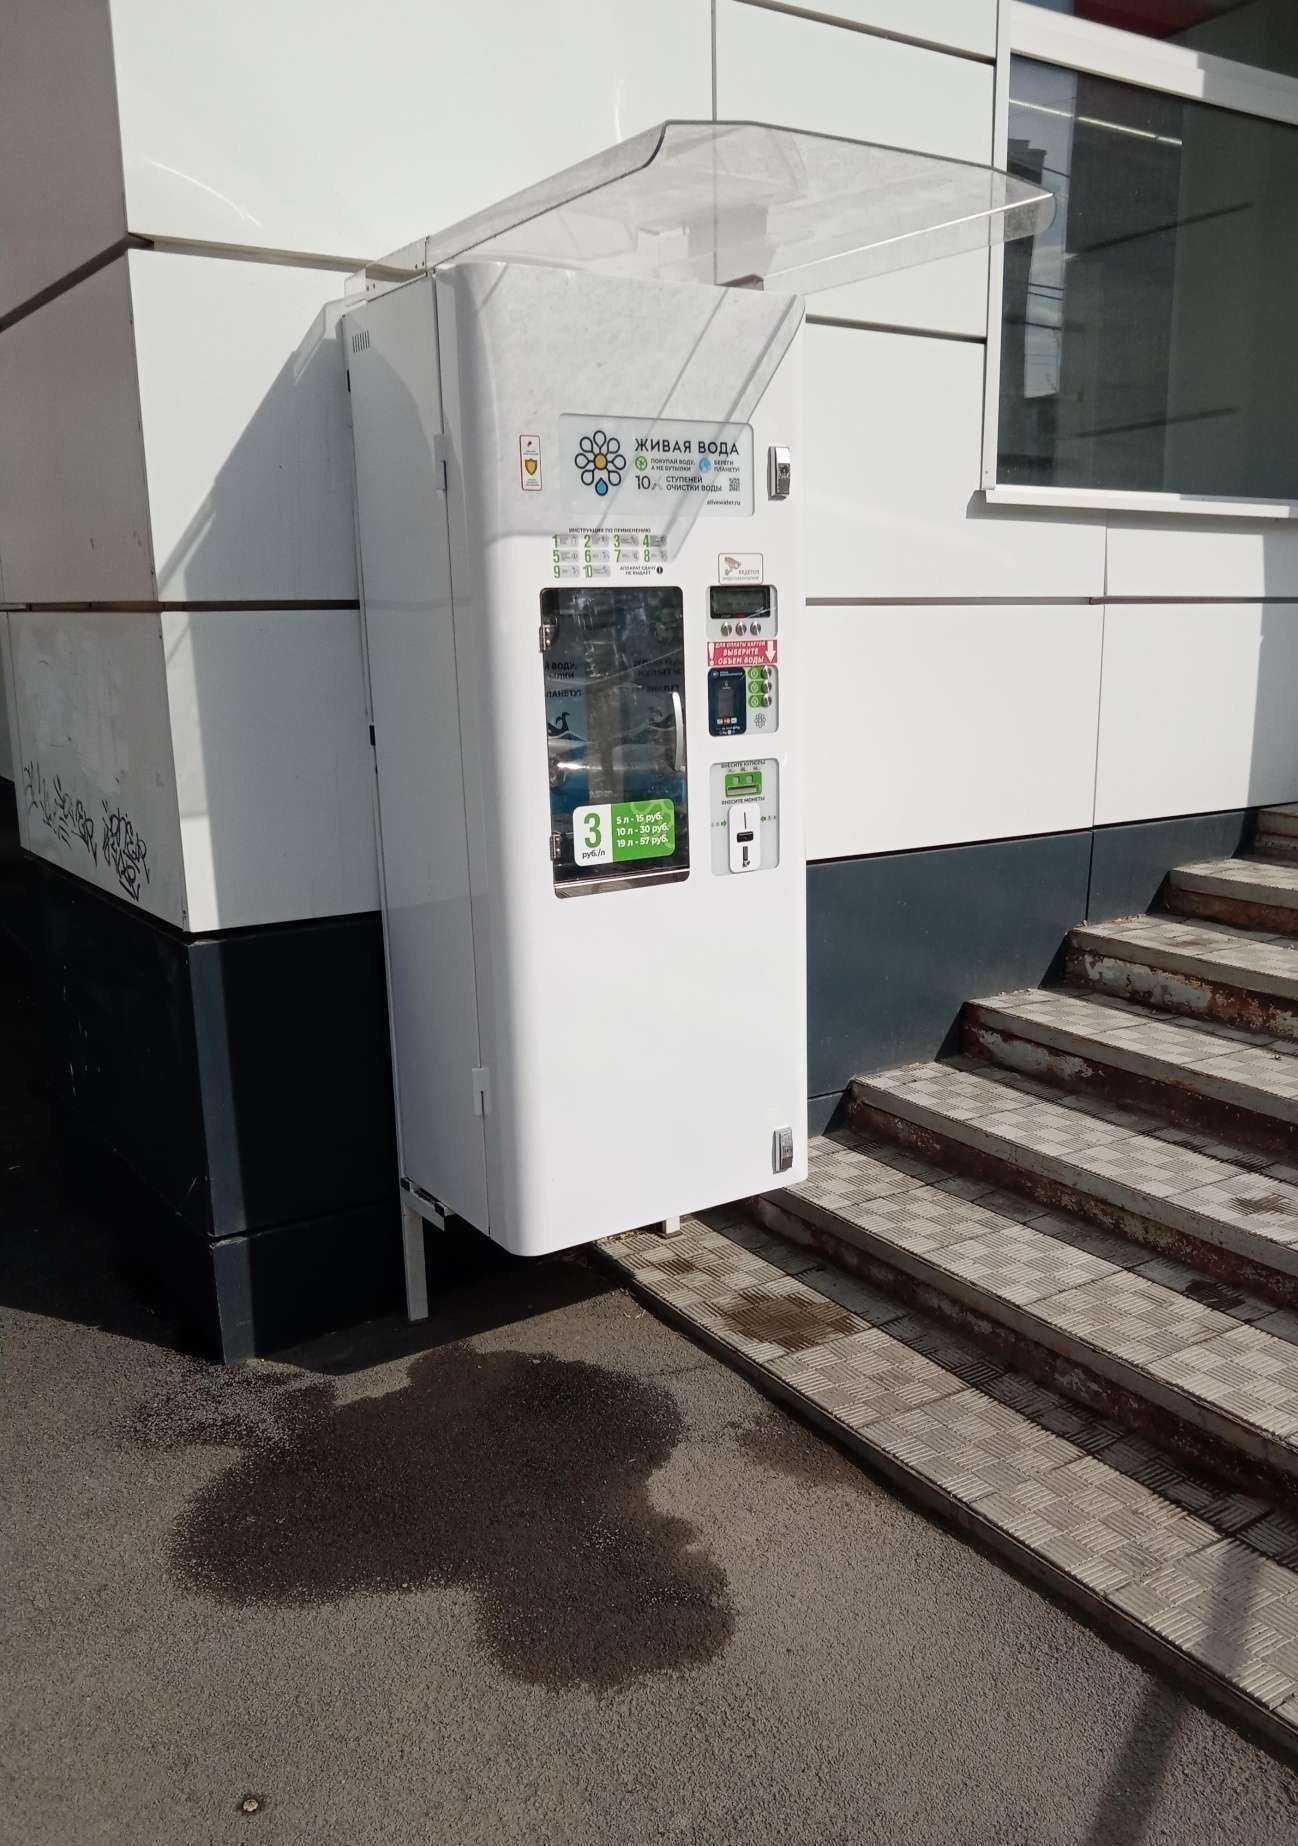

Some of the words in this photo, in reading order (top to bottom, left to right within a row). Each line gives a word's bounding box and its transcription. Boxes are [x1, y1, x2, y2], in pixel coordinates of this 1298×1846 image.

[634, 438, 692, 454] ЖИВАЯ
[697, 440, 740, 457] ВОДА
[650, 457, 678, 465] ПОКУПАЙ
[634, 475, 651, 490] 10
[665, 475, 703, 483] СТУПЕНЕЙ
[666, 484, 700, 492] ОЧИСТКИ
[701, 485, 722, 493] ВОДЫ
[584, 534, 592, 548] 2
[614, 534, 621, 548] 3
[642, 534, 650, 548] 4
[552, 549, 560, 563] 5
[584, 549, 592, 563] 6
[614, 549, 621, 563] 7
[643, 549, 650, 563] 8
[553, 565, 560, 579] 9
[583, 565, 593, 579] 10
[723, 648, 759, 657] ВЫБЕРИТЕ
[743, 656, 764, 665] ВОДЫ
[616, 816, 622, 825] 5
[635, 814, 644, 822] 15
[646, 812, 664, 823] руб.
[583, 812, 602, 849] 3
[616, 828, 626, 836] 10
[640, 825, 651, 833] 30
[652, 823, 670, 834] руб.
[616, 839, 626, 848] 19
[640, 837, 650, 846] 57
[651, 834, 669, 846] руб.
[582, 848, 606, 860] руб./л
